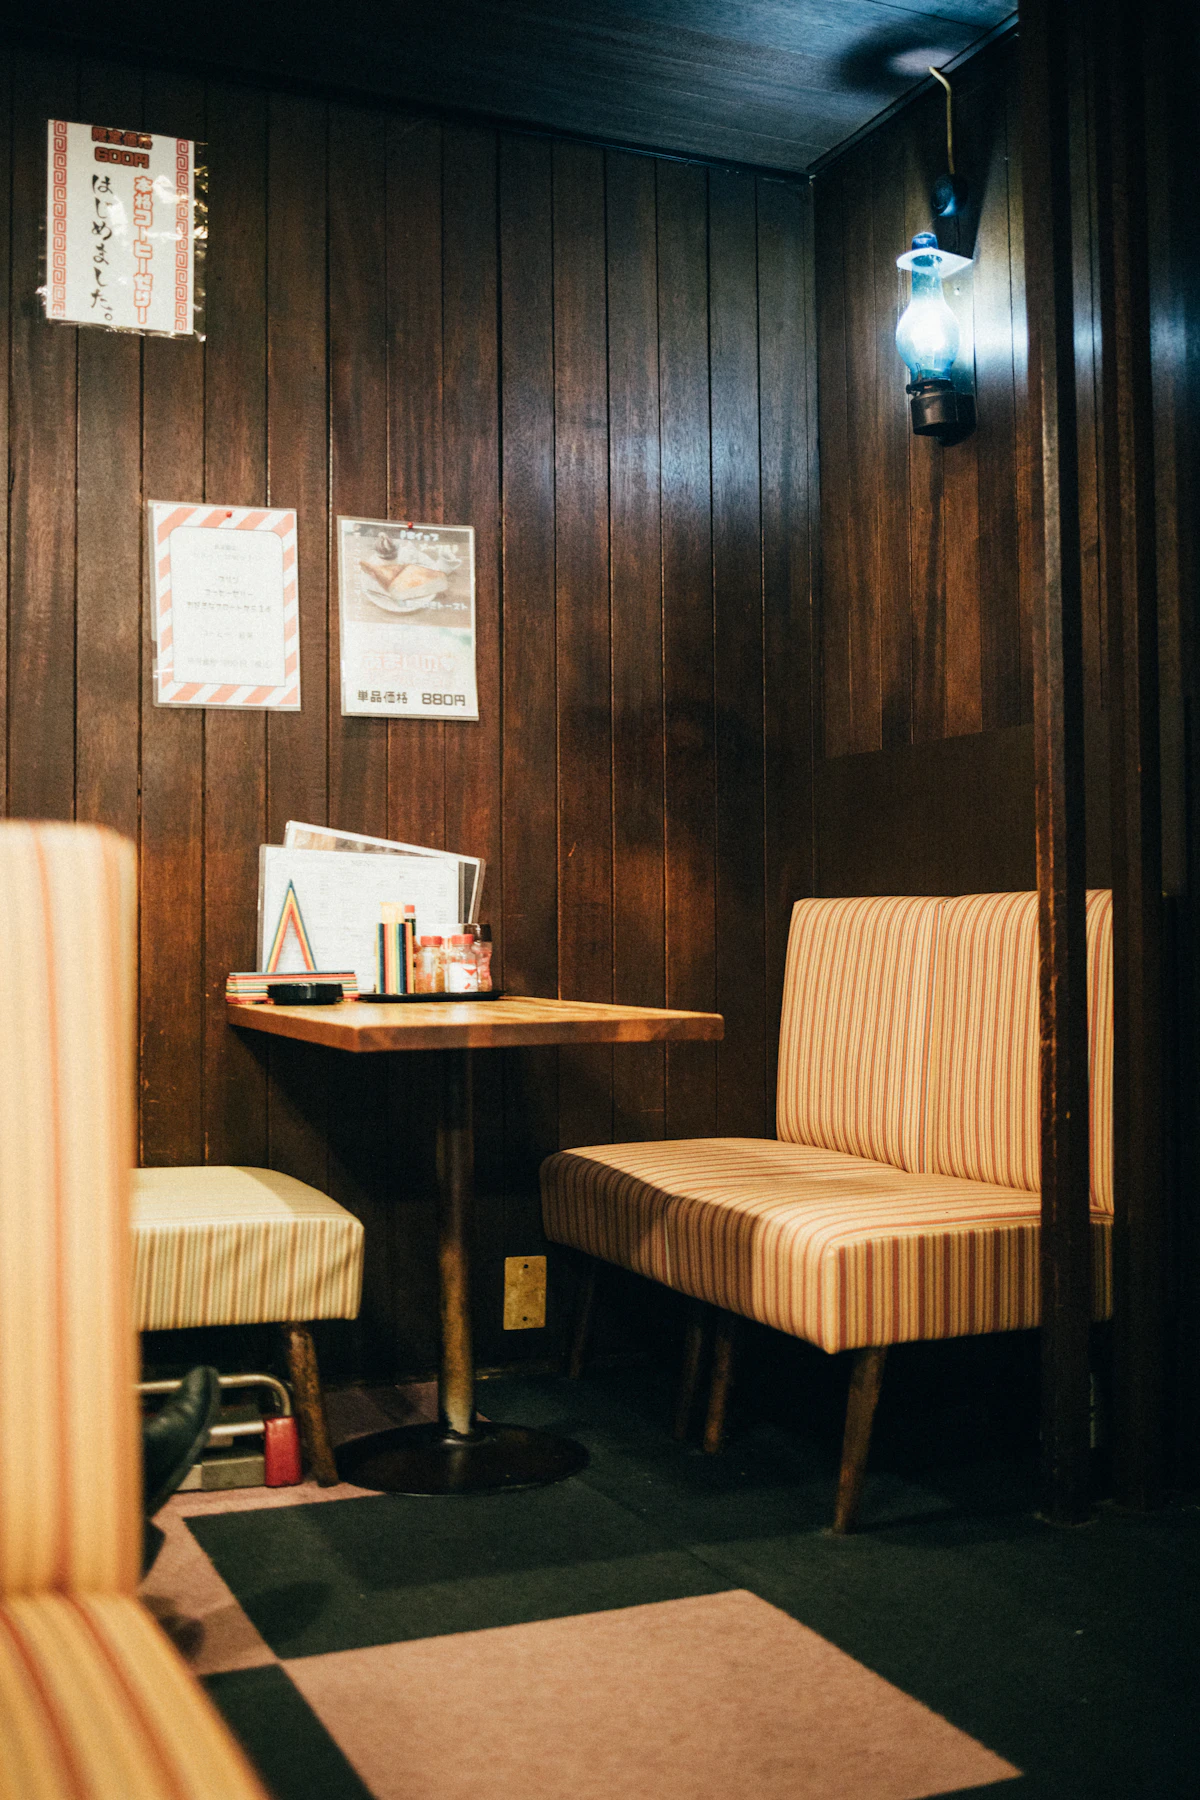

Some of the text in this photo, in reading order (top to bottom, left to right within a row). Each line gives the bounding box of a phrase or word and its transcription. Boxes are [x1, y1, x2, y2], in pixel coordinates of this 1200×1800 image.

[94, 147, 150, 169] 600円
[91, 174, 114, 321] はじめました。
[421, 693, 466, 707] 880円
